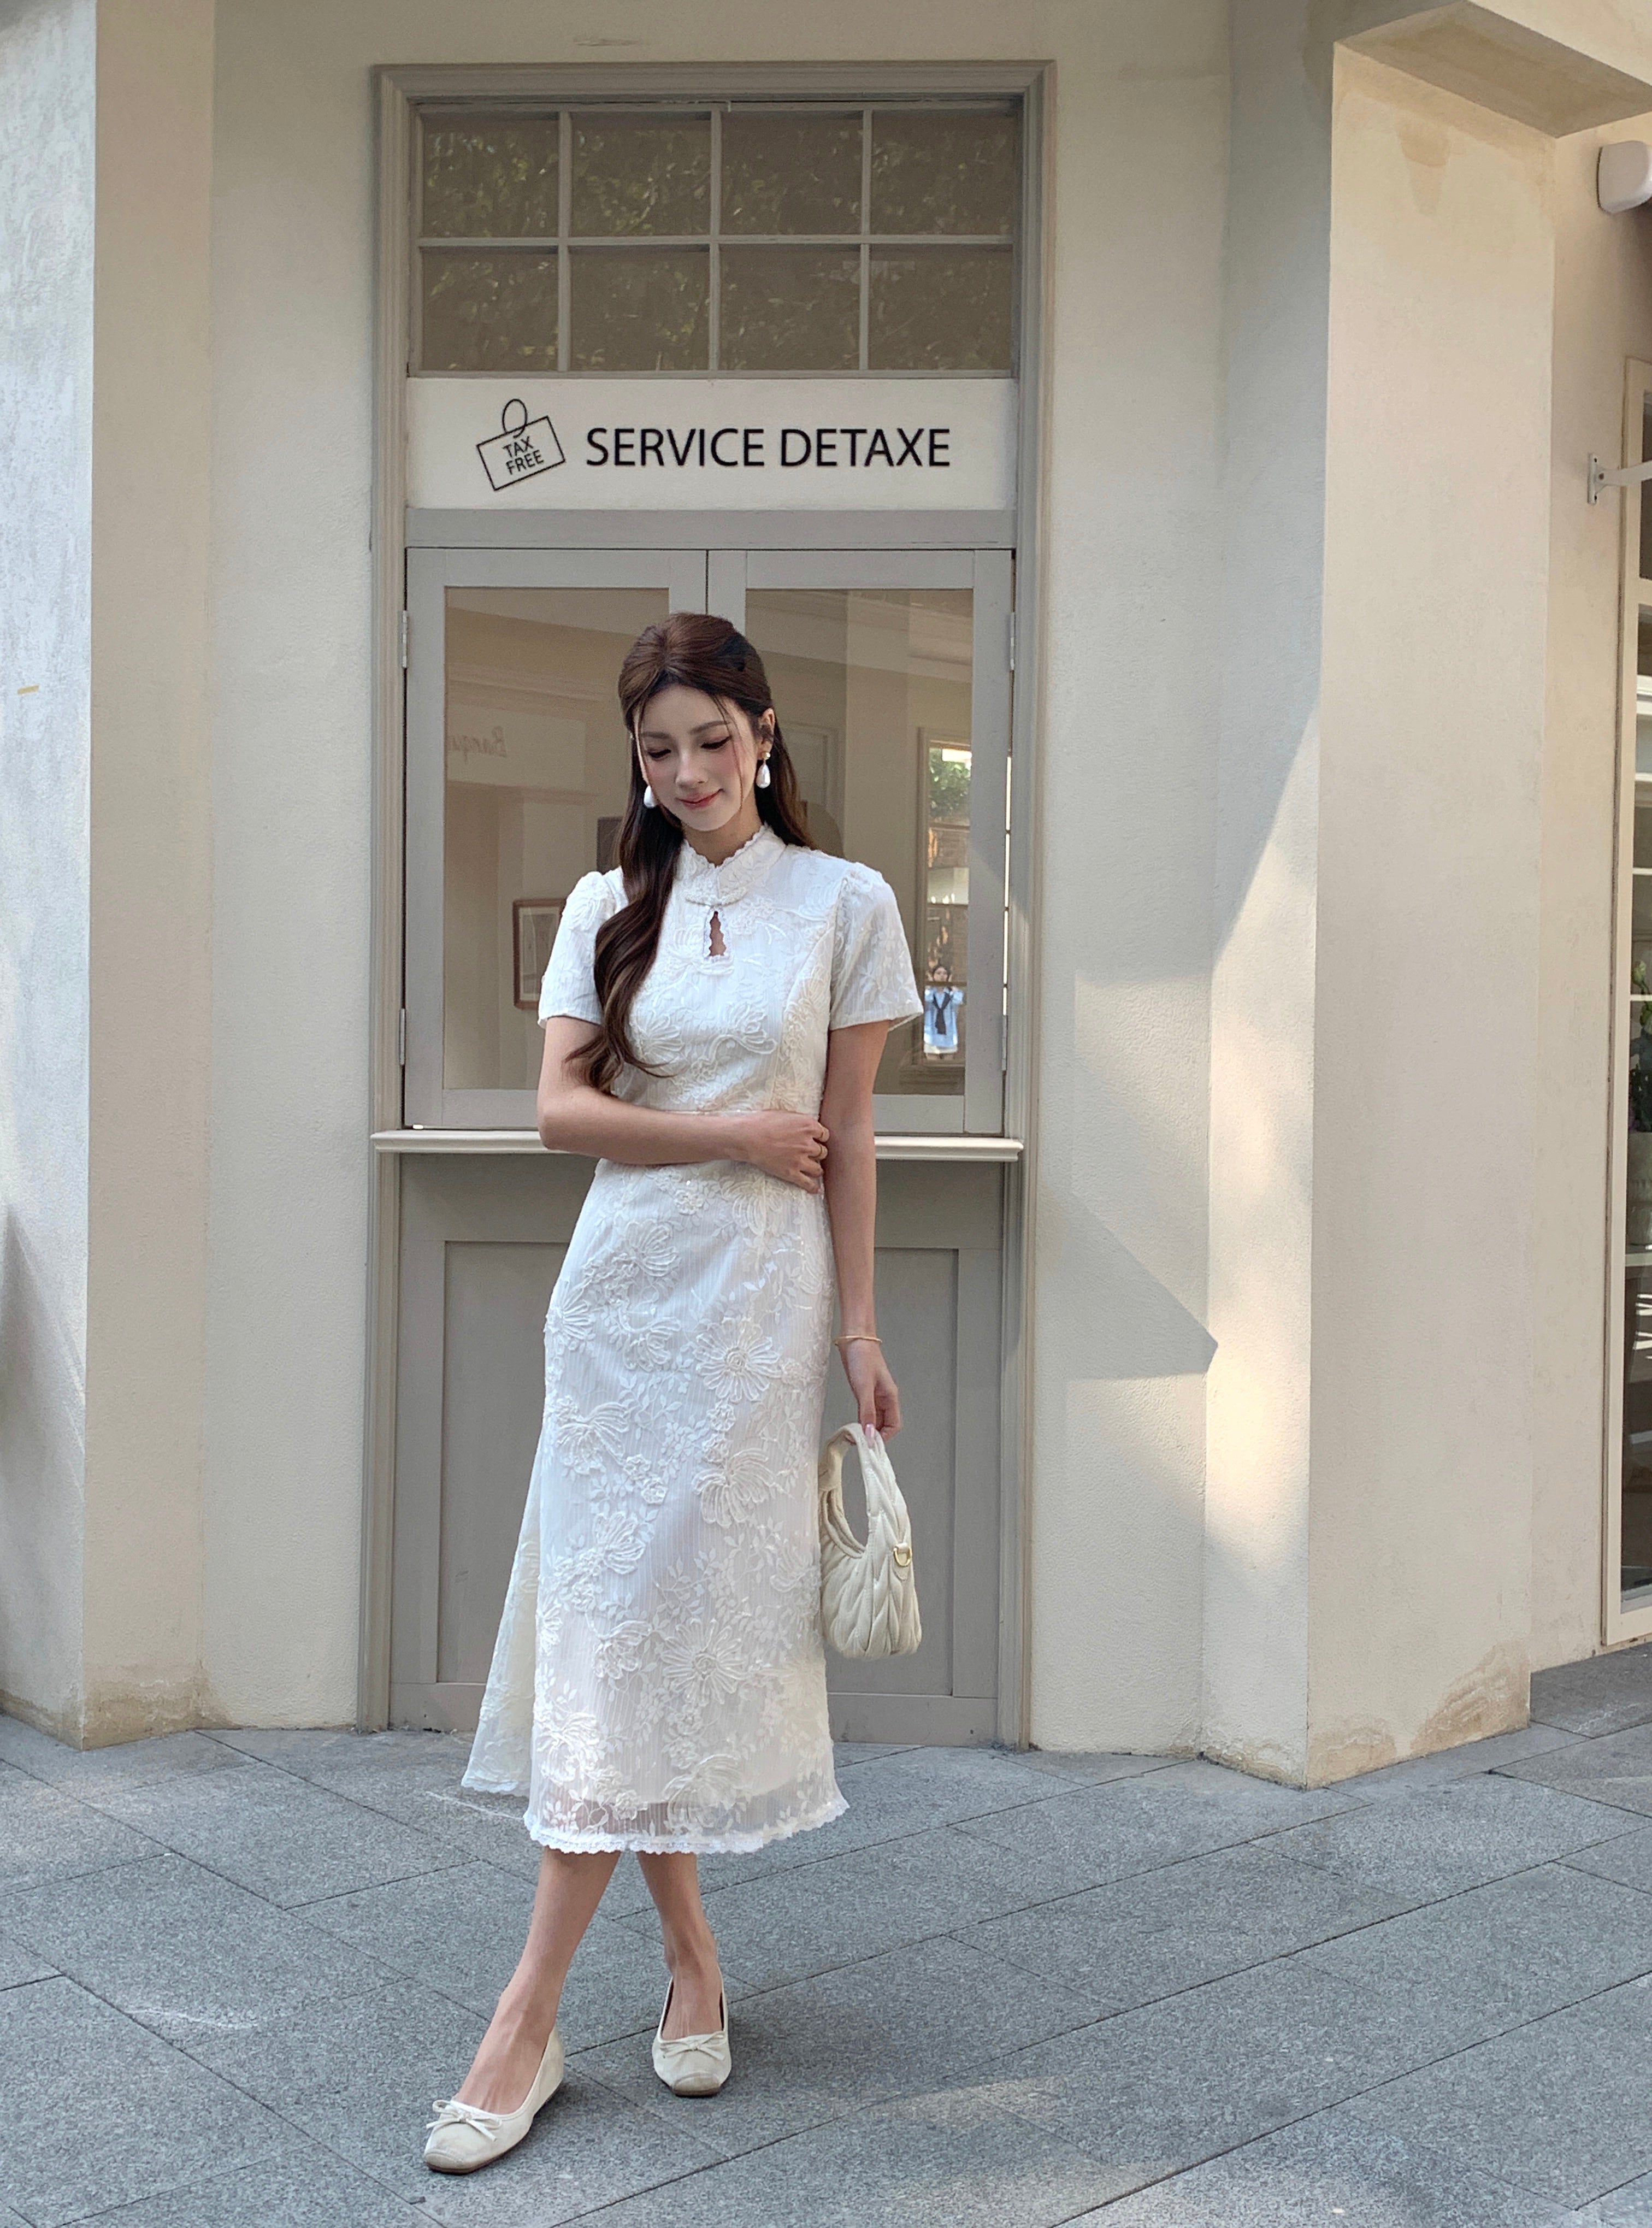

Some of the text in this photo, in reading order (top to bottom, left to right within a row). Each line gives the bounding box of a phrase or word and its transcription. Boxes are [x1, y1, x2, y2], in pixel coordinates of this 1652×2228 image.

[503, 436, 533, 458] TAX
[586, 427, 951, 468] SERVICE DETAXE
[505, 450, 544, 475] FREE
